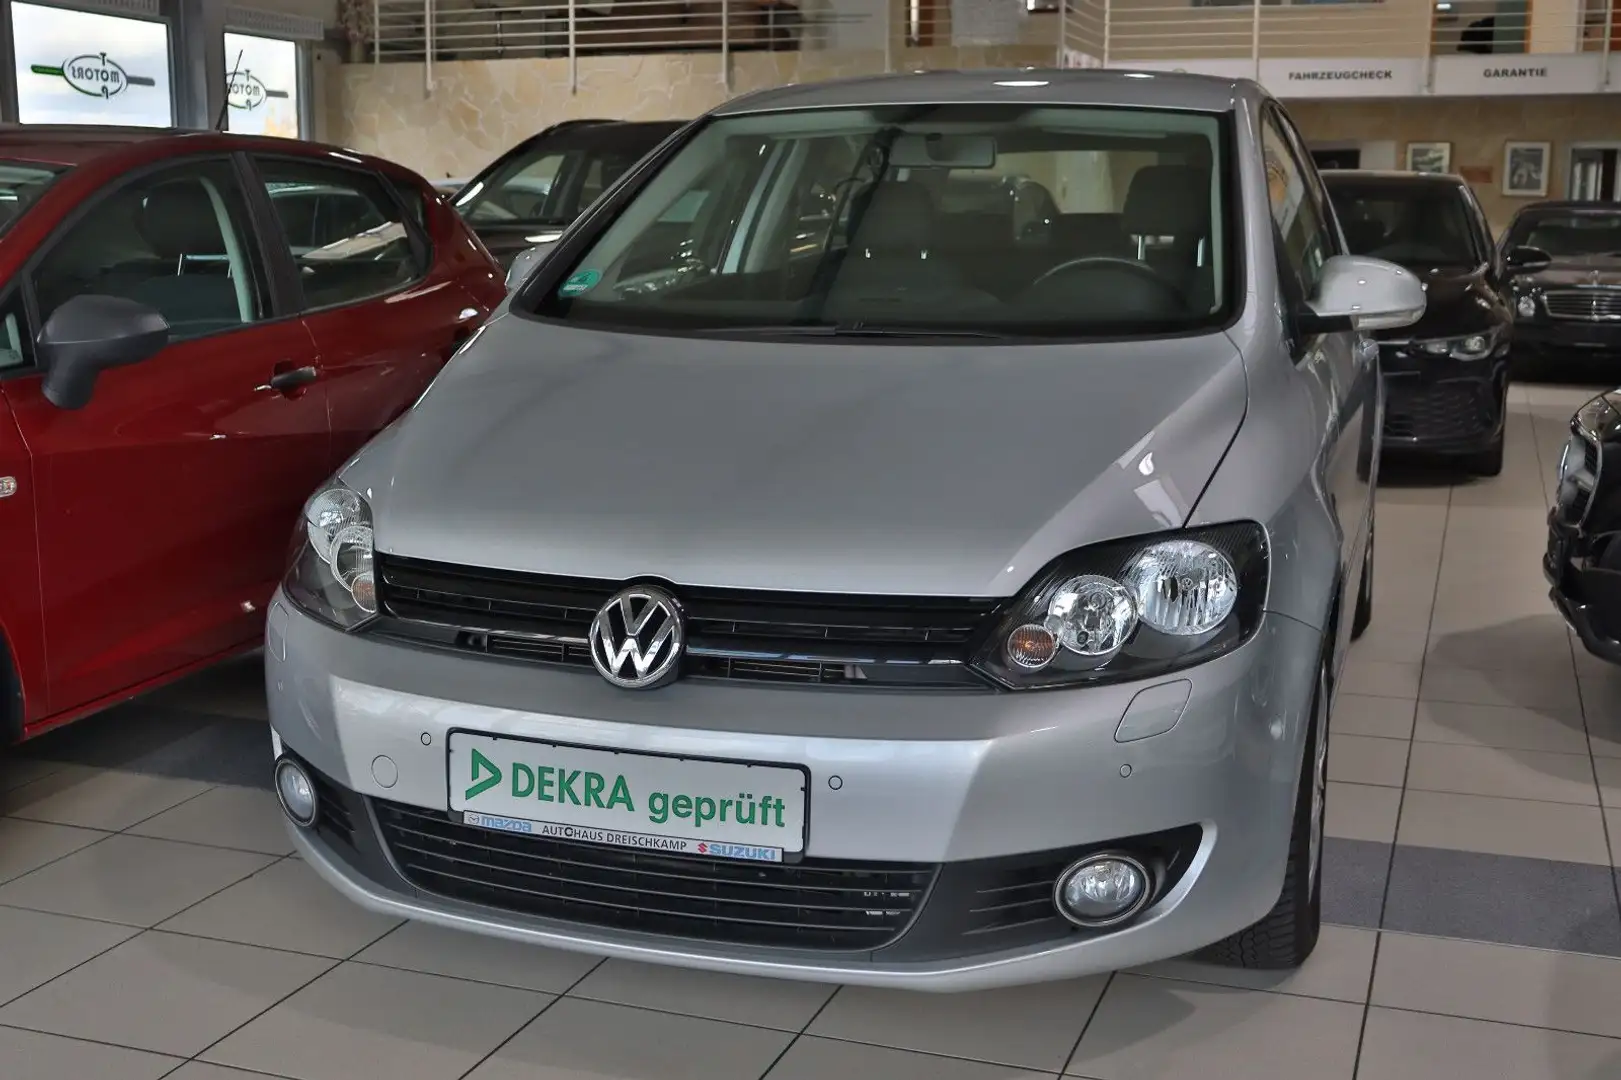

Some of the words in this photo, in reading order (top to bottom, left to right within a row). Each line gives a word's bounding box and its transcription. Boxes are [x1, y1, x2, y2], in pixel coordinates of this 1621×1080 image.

[1288, 70, 1393, 81] FAHRZEUGCHECK
[1483, 67, 1549, 79] GARANTIE
[511, 762, 635, 812] DEKRA
[648, 792, 786, 828] geprüft
[480, 815, 532, 833] mazda
[541, 824, 603, 842] AUTOHAUS
[606, 832, 687, 851] DREISCHKAMP
[709, 843, 776, 861] SUZUKI
